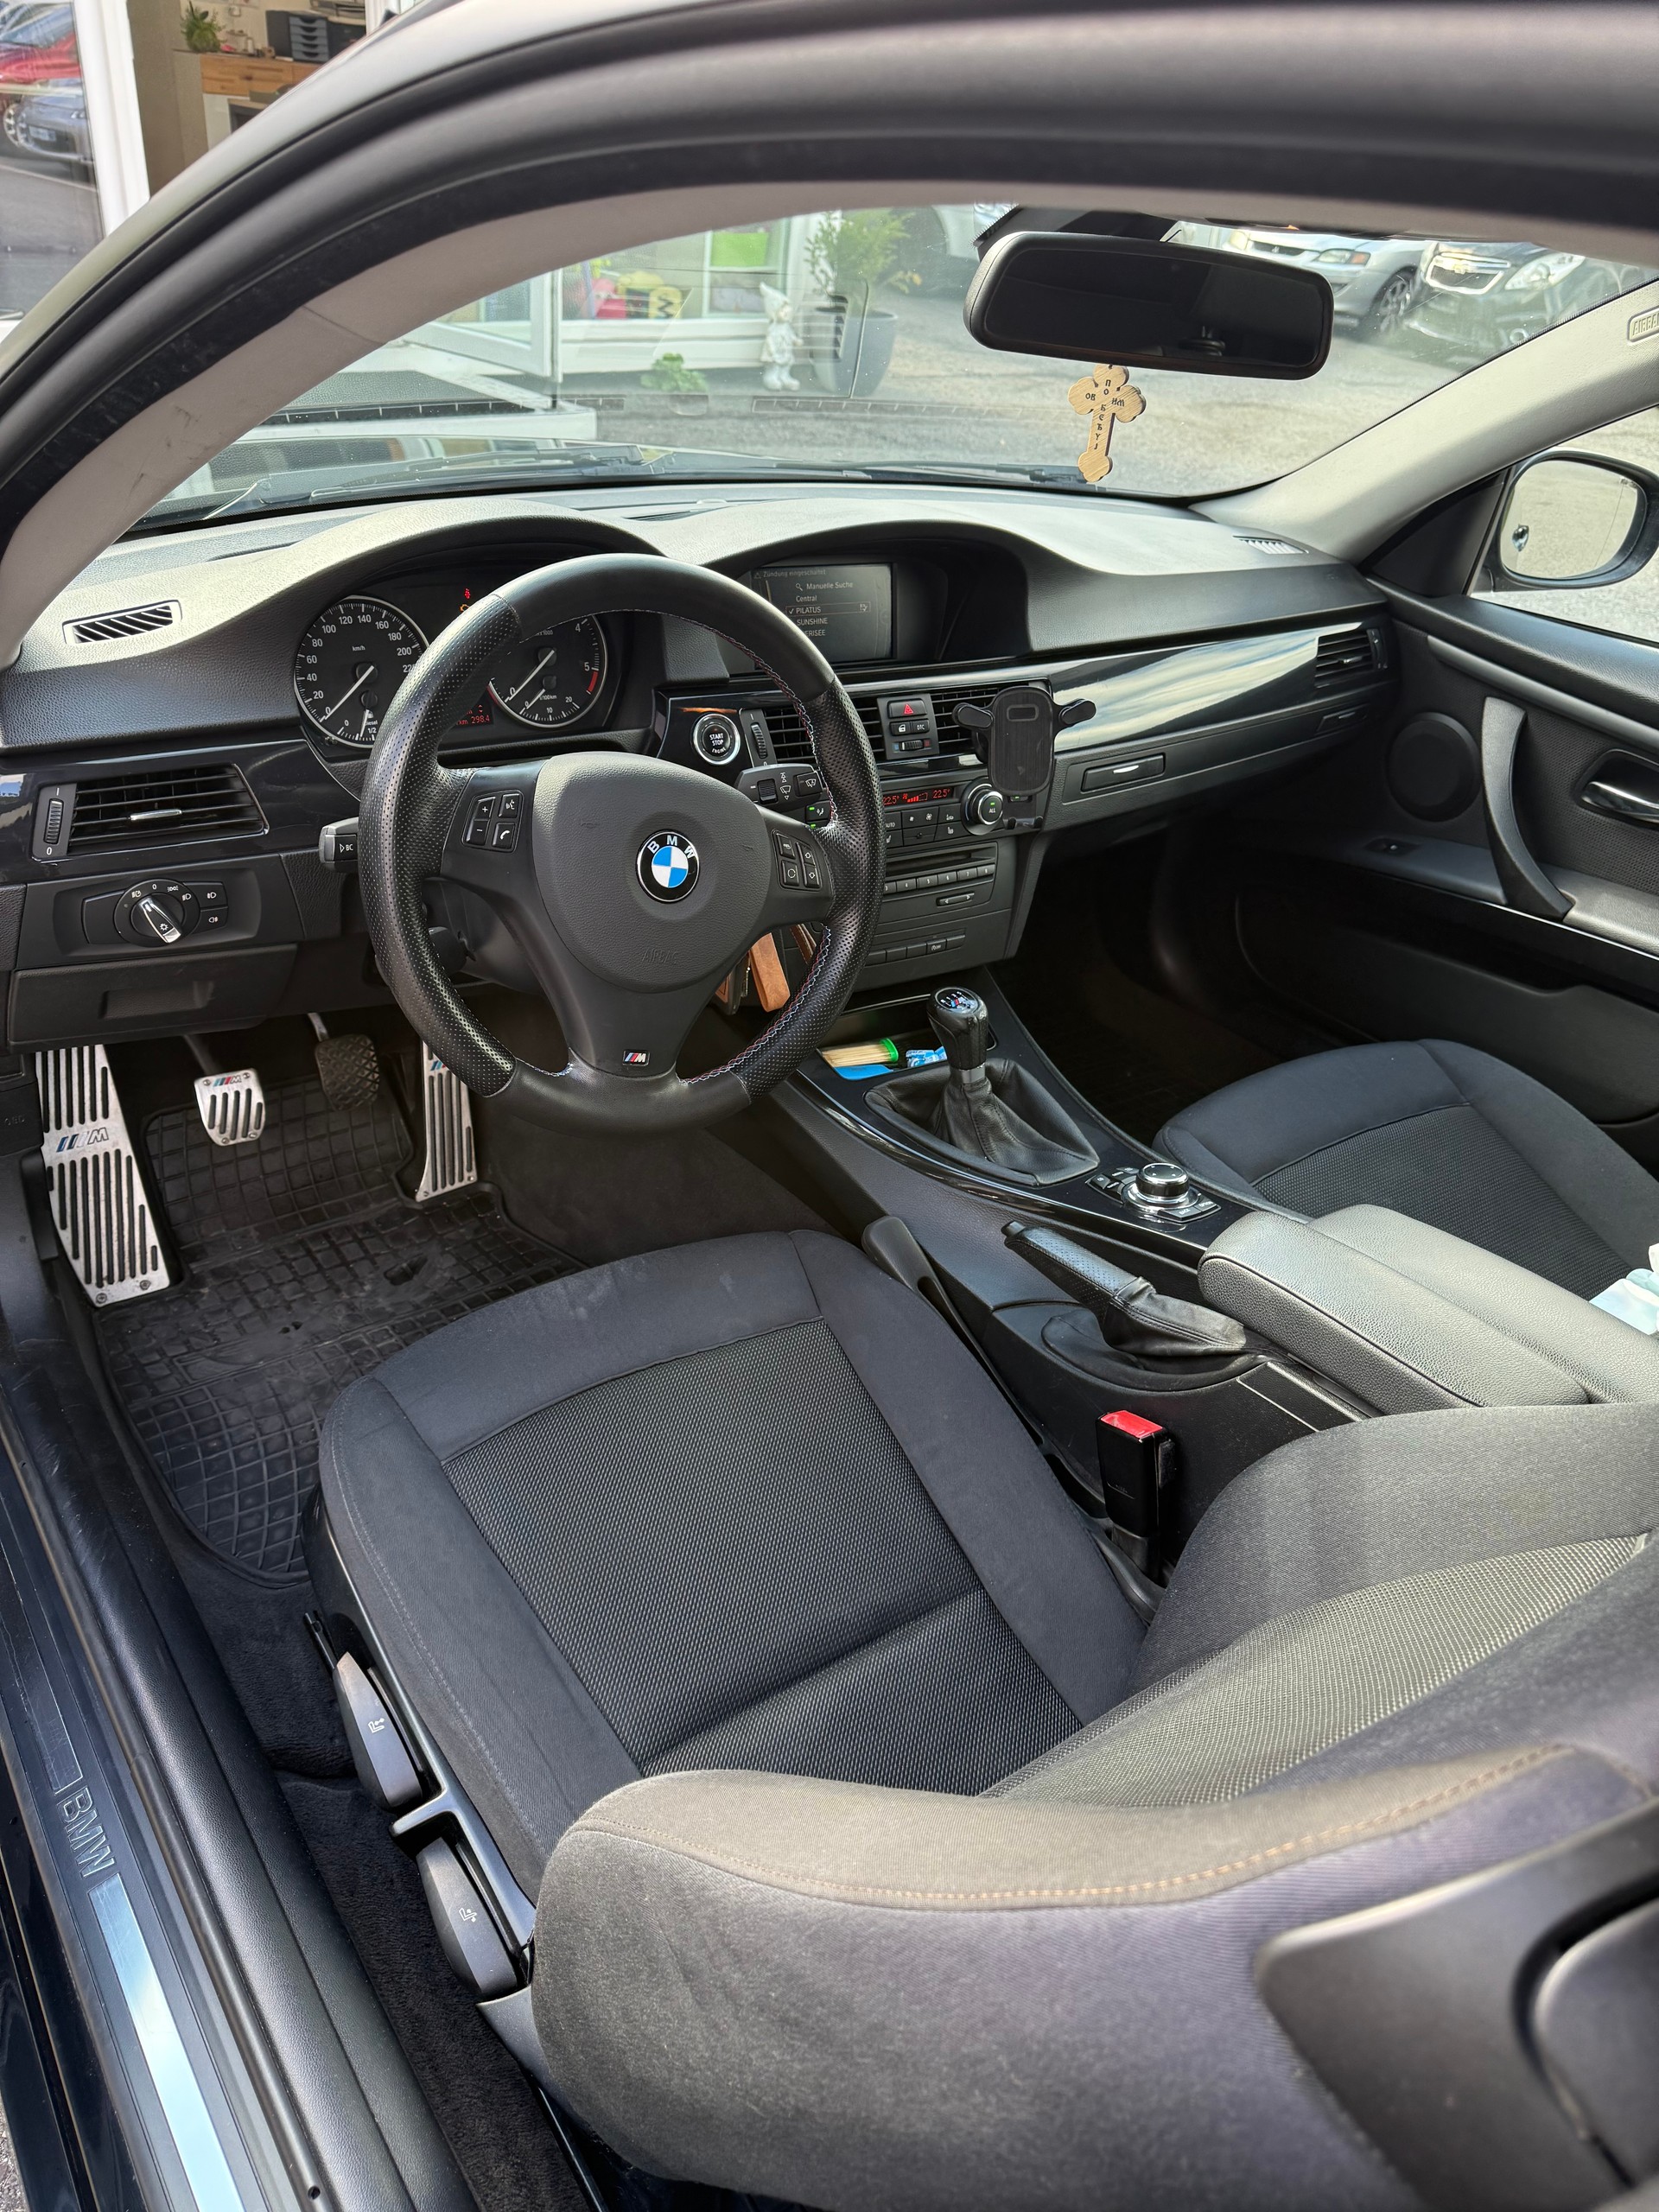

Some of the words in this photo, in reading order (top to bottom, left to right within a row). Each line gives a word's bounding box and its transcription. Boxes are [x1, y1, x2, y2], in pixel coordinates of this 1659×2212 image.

[1631, 312, 1659, 336] AIRBA
[806, 582, 834, 590] Manuelle
[796, 606, 822, 614] PILATUS
[339, 616, 353, 625] 120
[357, 614, 372, 623] 140
[797, 617, 829, 626] SUNSHINE
[321, 624, 336, 633] 100
[375, 620, 389, 630] 160
[575, 623, 581, 632] 4
[388, 632, 402, 641] 180
[312, 639, 323, 647] 80
[397, 646, 412, 656] 200
[584, 661, 590, 671] 5
[306, 673, 317, 682] 40
[313, 690, 324, 699] 20
[471, 715, 490, 724] 298.4
[647, 835, 696, 859] BMW
[56, 1785, 116, 1879] BMW
